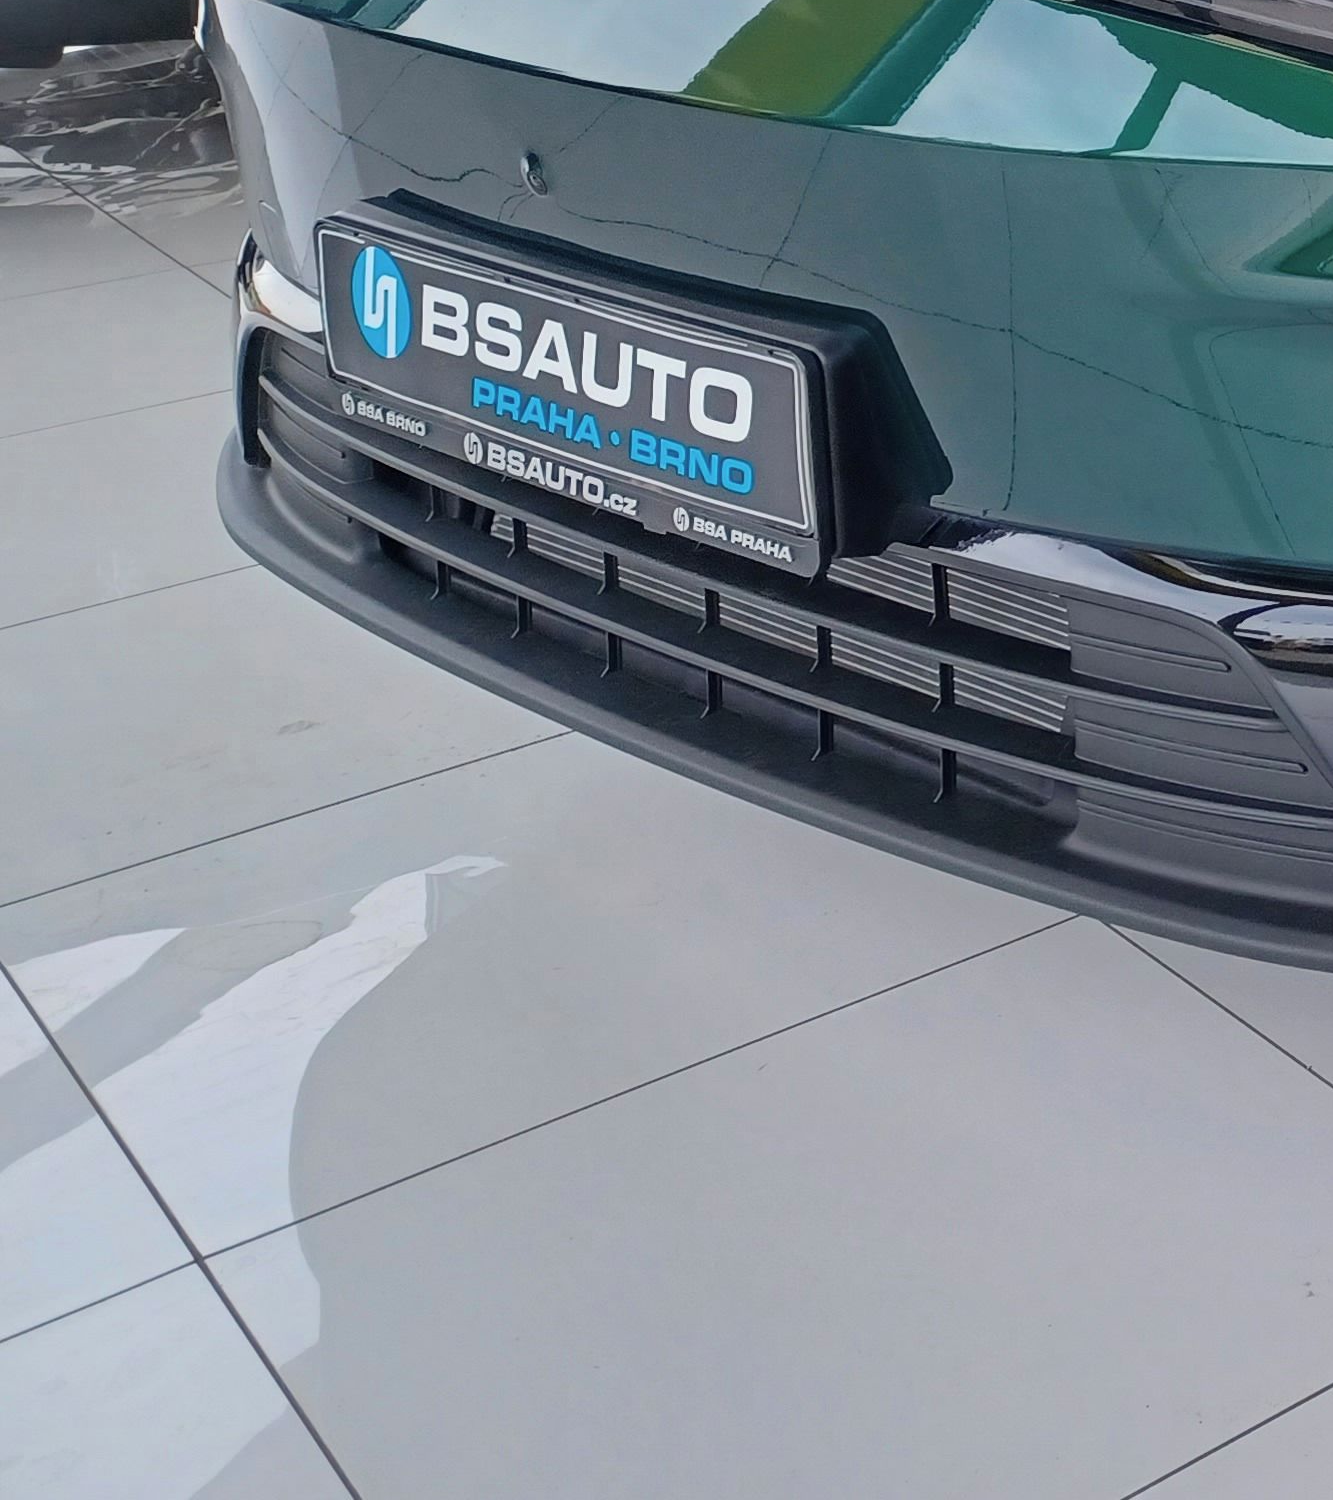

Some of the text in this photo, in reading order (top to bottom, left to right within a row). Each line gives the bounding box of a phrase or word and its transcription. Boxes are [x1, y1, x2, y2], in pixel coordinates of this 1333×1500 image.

[421, 283, 753, 443] BSAUTO
[356, 400, 427, 438] BSA BRNO
[471, 377, 753, 495] PRAHA BRNO
[692, 506, 793, 563] BSA PRAHA
